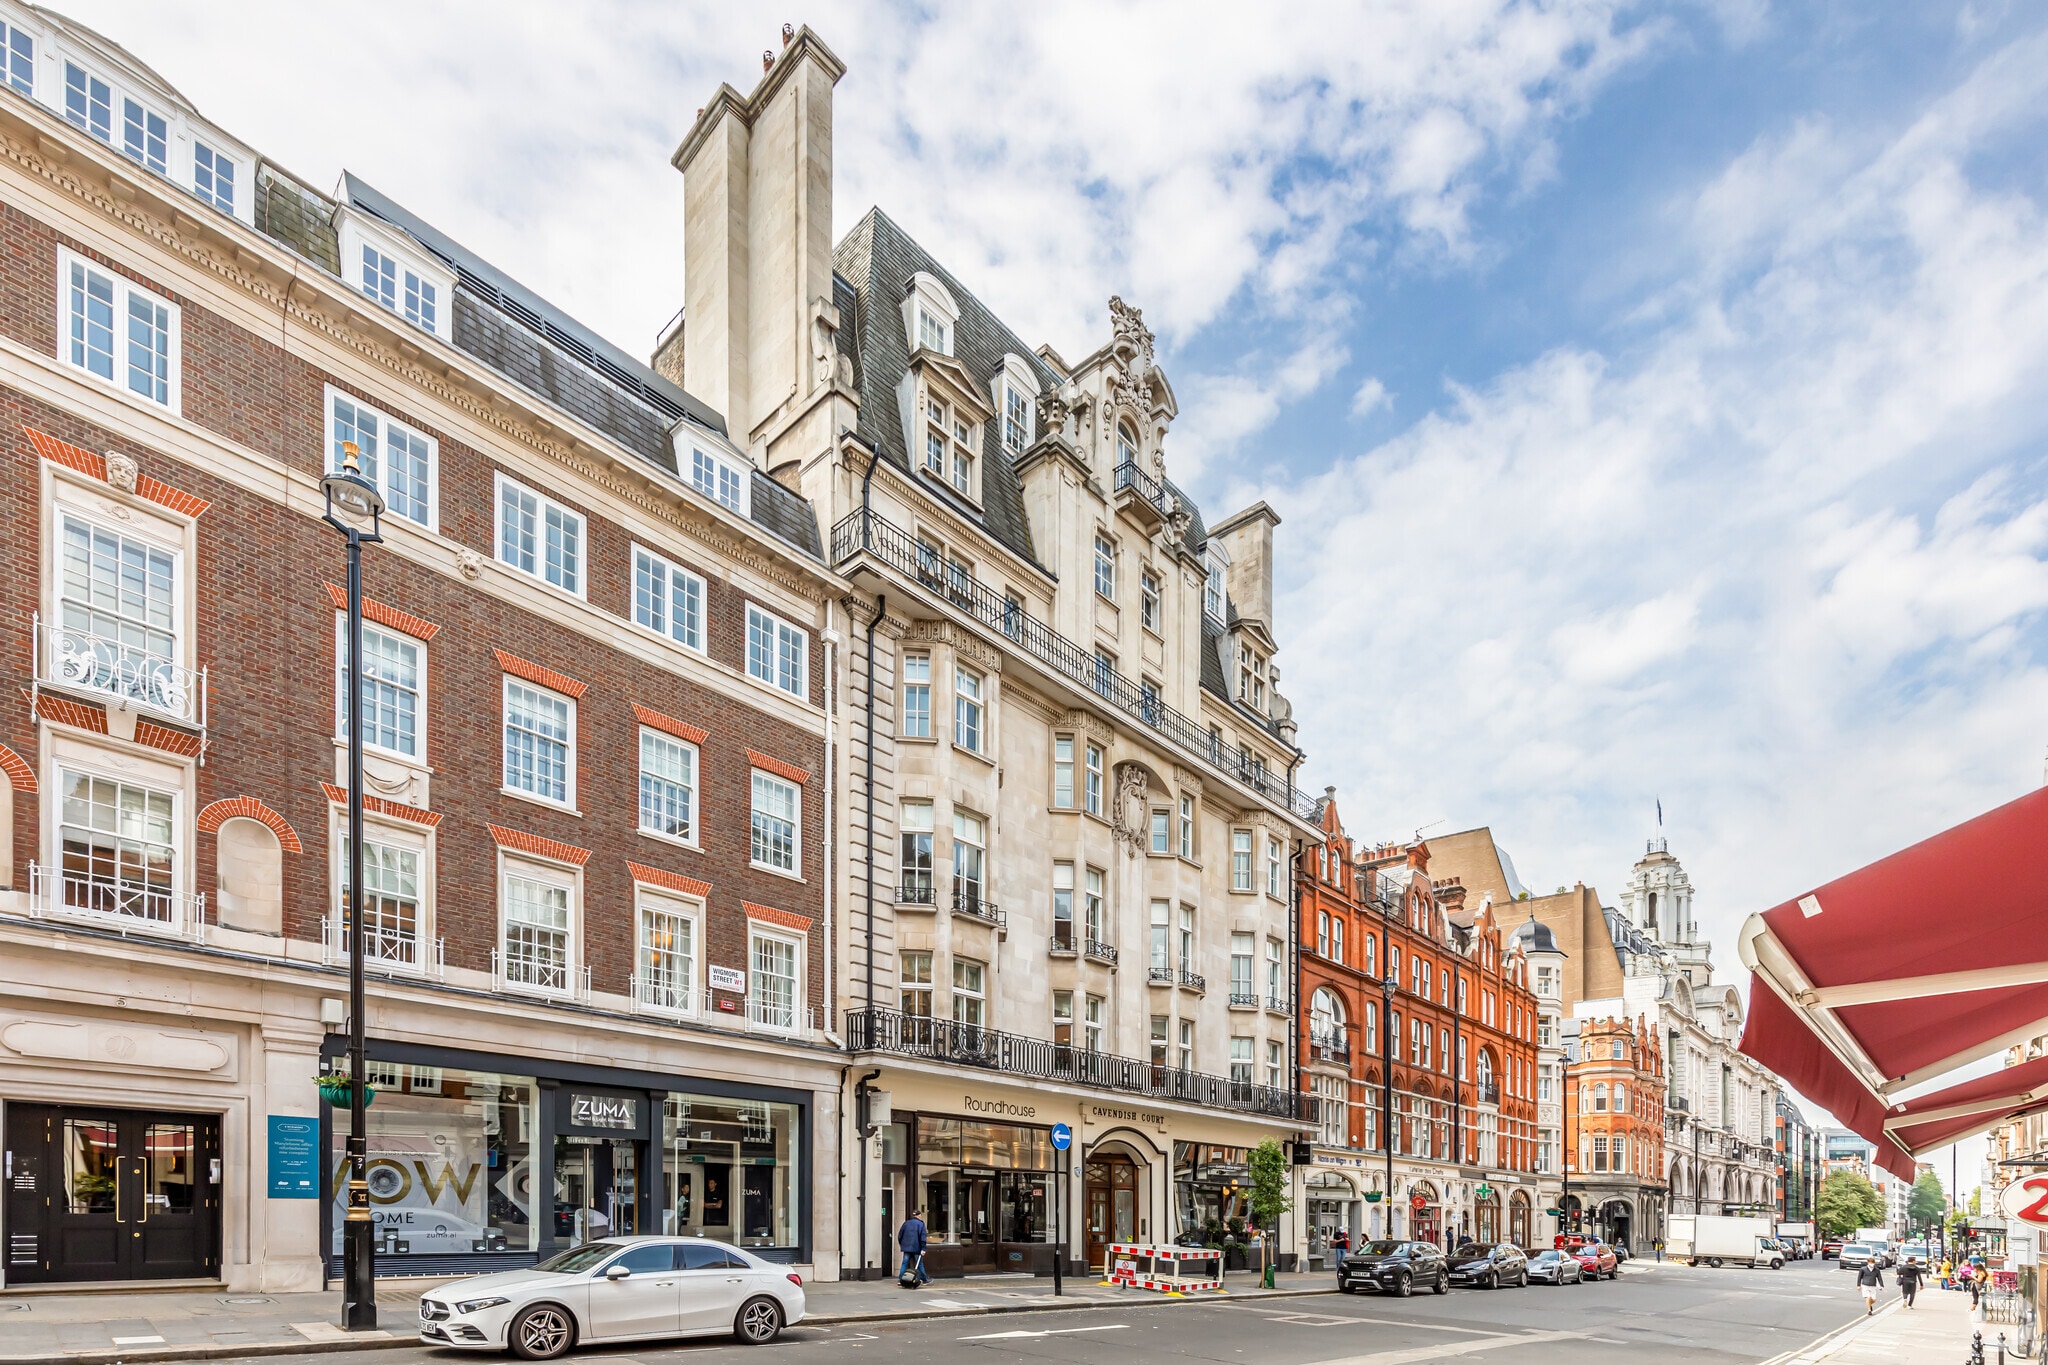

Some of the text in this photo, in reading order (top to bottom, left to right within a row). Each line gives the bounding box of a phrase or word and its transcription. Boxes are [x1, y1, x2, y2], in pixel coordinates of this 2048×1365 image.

[713, 968, 738, 978] WIGMORE
[713, 975, 732, 983] STREET
[578, 1100, 630, 1118] ZUMA
[964, 1096, 1036, 1118] Roundhouse
[1092, 1106, 1165, 1124] CAVENDISH COURT
[333, 1158, 482, 1206] OW
[741, 1188, 761, 1196] ZUMA
[372, 1212, 414, 1224] OME
